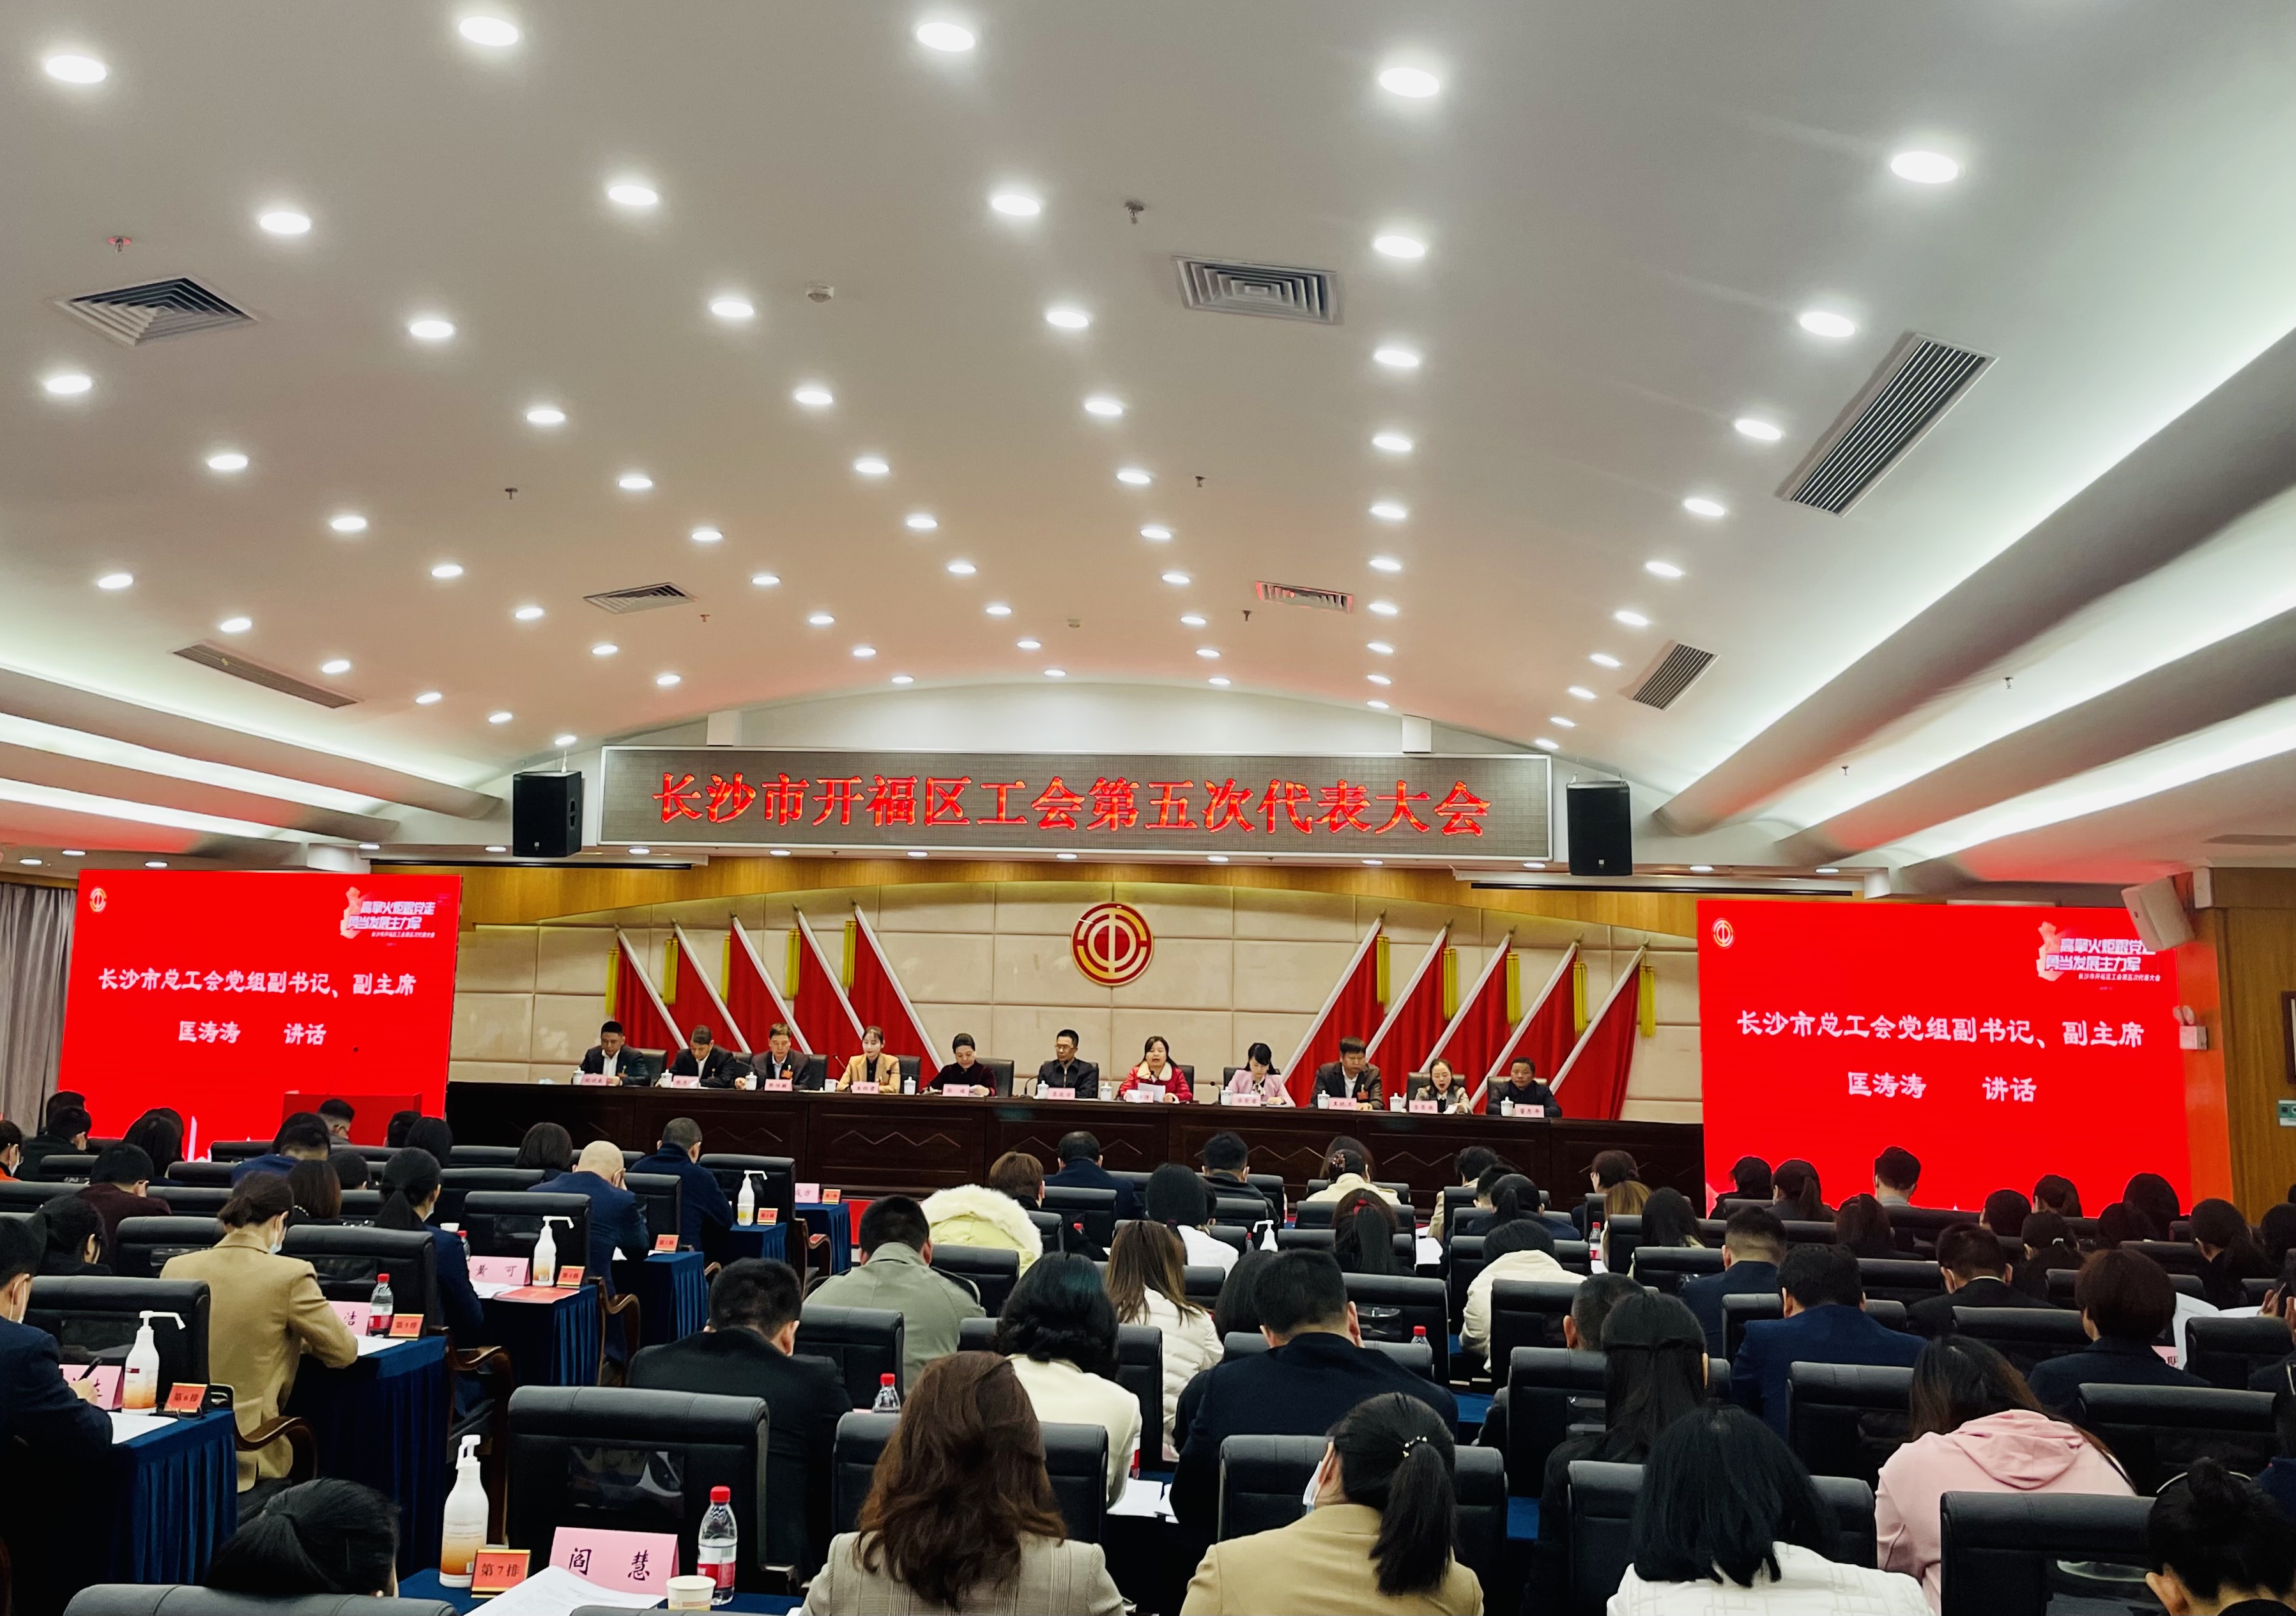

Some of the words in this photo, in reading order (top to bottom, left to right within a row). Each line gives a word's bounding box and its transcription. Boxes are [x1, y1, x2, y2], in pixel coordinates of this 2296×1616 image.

[652, 771, 1490, 836] 长沙市开福区工会第五次代表大会
[178, 1020, 241, 1043] 匡涛涛
[283, 1023, 327, 1045] 讲话
[1848, 1072, 1927, 1099] 匡涛涛
[1982, 1076, 2037, 1102] 讲话
